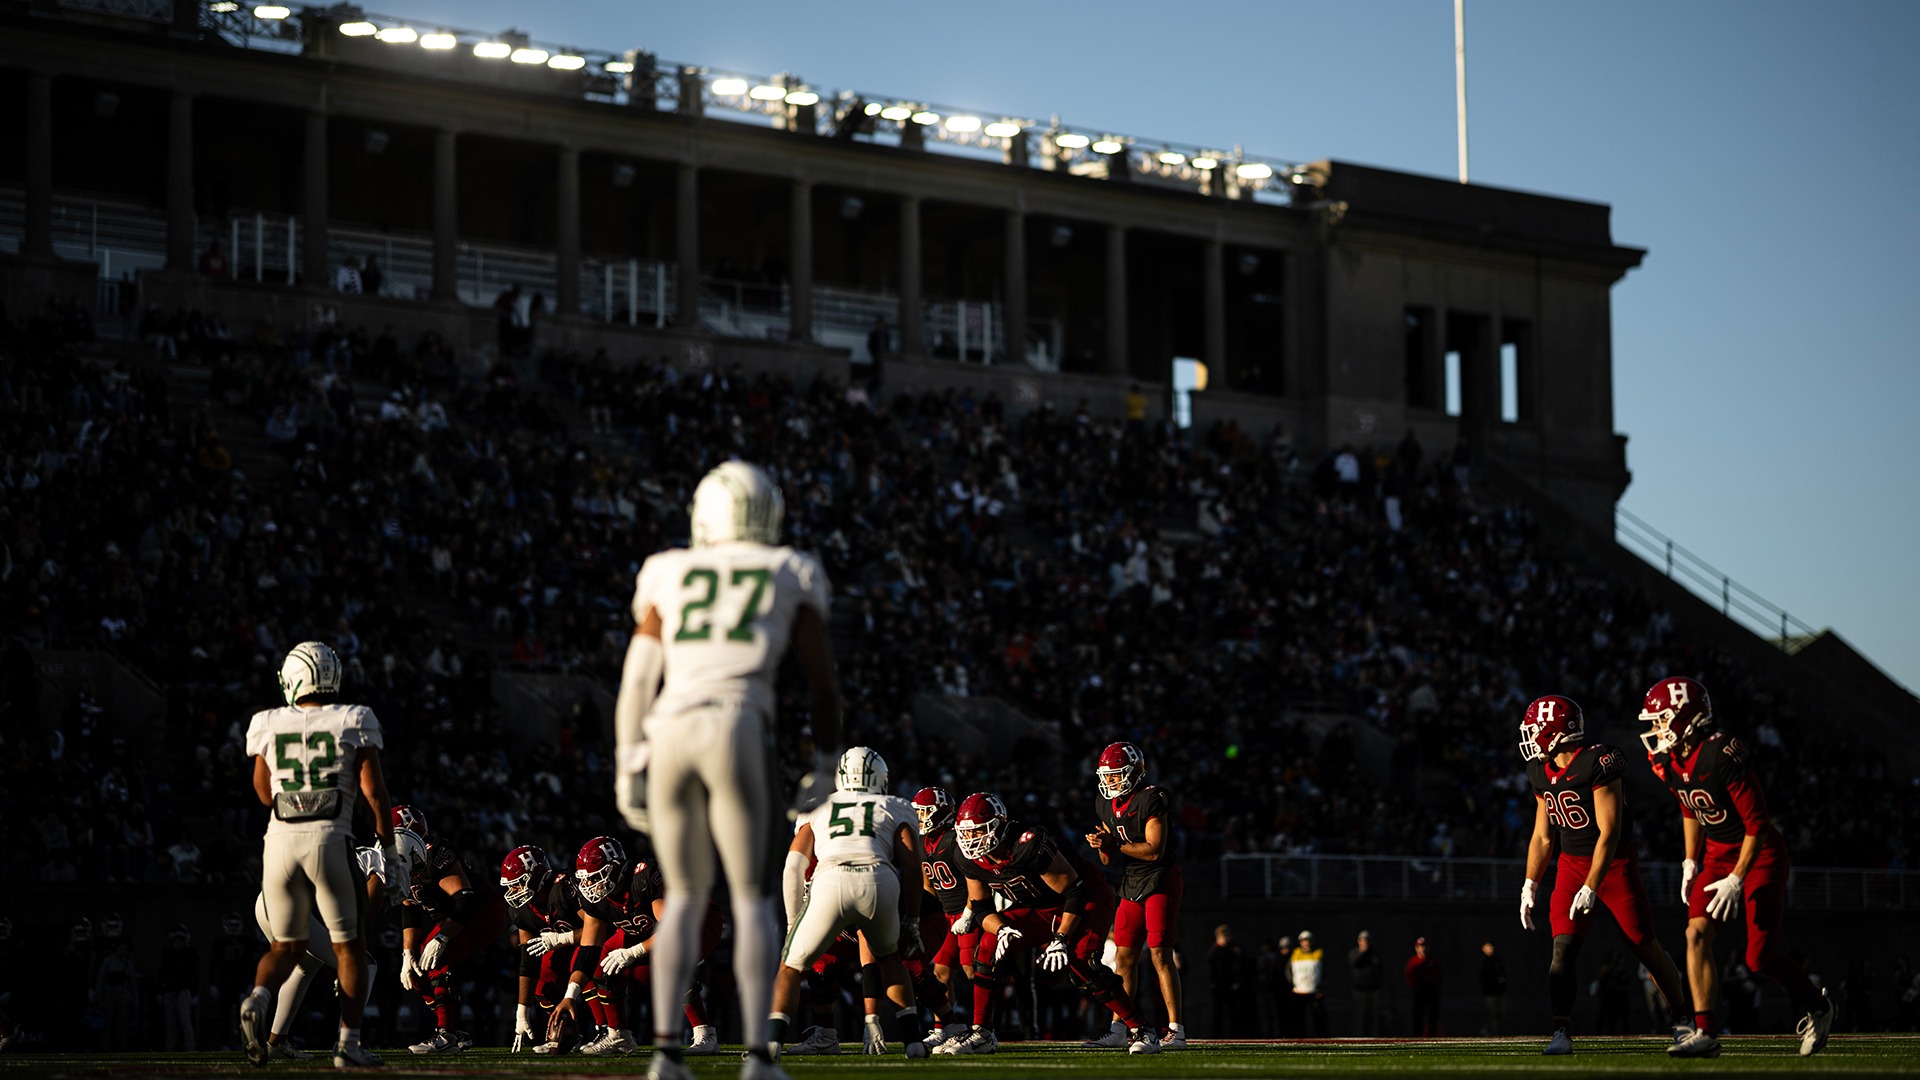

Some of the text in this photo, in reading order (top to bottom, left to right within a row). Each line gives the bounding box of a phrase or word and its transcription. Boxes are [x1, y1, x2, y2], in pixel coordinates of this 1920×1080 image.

[674, 568, 770, 642] 27
[1667, 682, 1690, 706] H
[1537, 701, 1556, 722] H
[275, 731, 338, 791] 52
[1122, 745, 1140, 764] H
[1599, 749, 1627, 774] 86
[933, 789, 948, 807] H
[1543, 790, 1590, 829] 86
[1677, 789, 1728, 827] 19
[396, 807, 419, 827] H
[829, 801, 876, 839] 51
[518, 850, 539, 872] H
[599, 842, 620, 862] H
